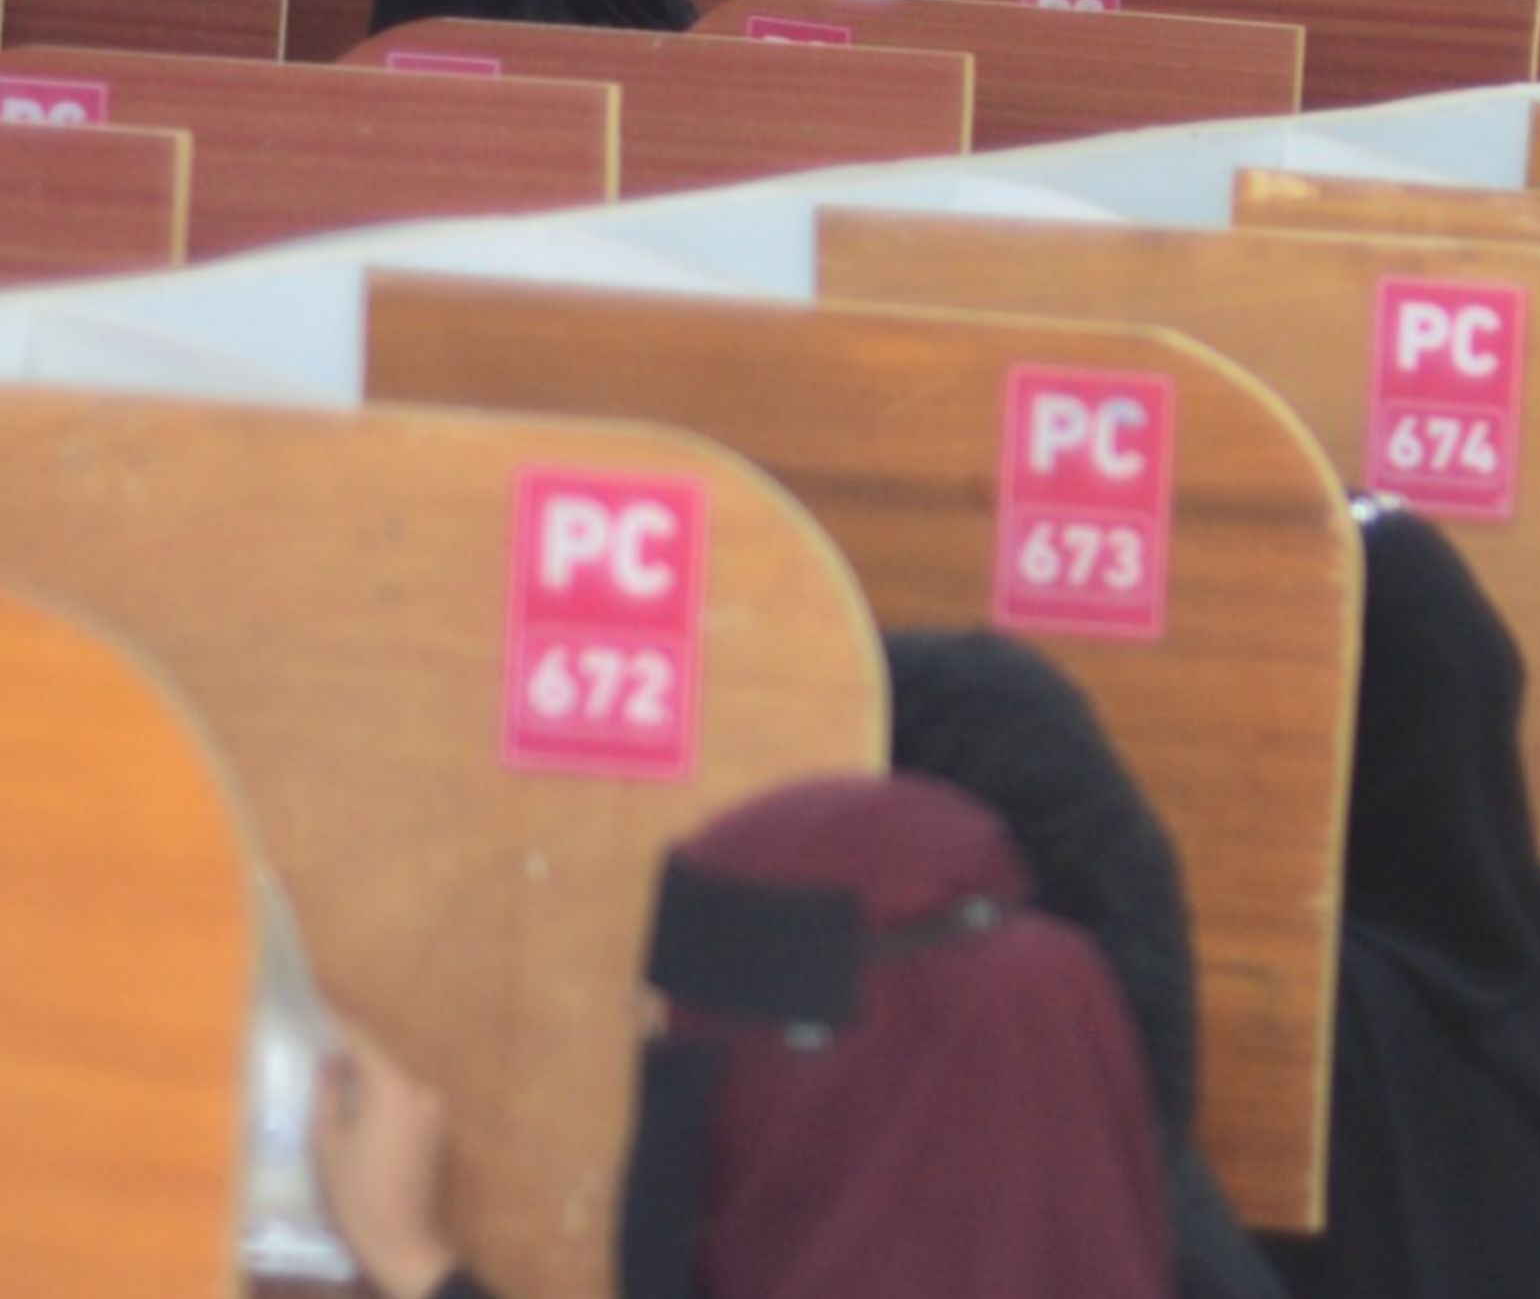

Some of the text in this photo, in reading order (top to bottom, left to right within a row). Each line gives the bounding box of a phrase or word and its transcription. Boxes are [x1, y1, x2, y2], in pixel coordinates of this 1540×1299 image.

[1398, 301, 1501, 377] PC
[1028, 392, 1147, 480] PC
[1387, 417, 1497, 475] 674
[540, 495, 676, 597] PC
[1018, 523, 1144, 591] 673
[527, 645, 675, 725] 672
